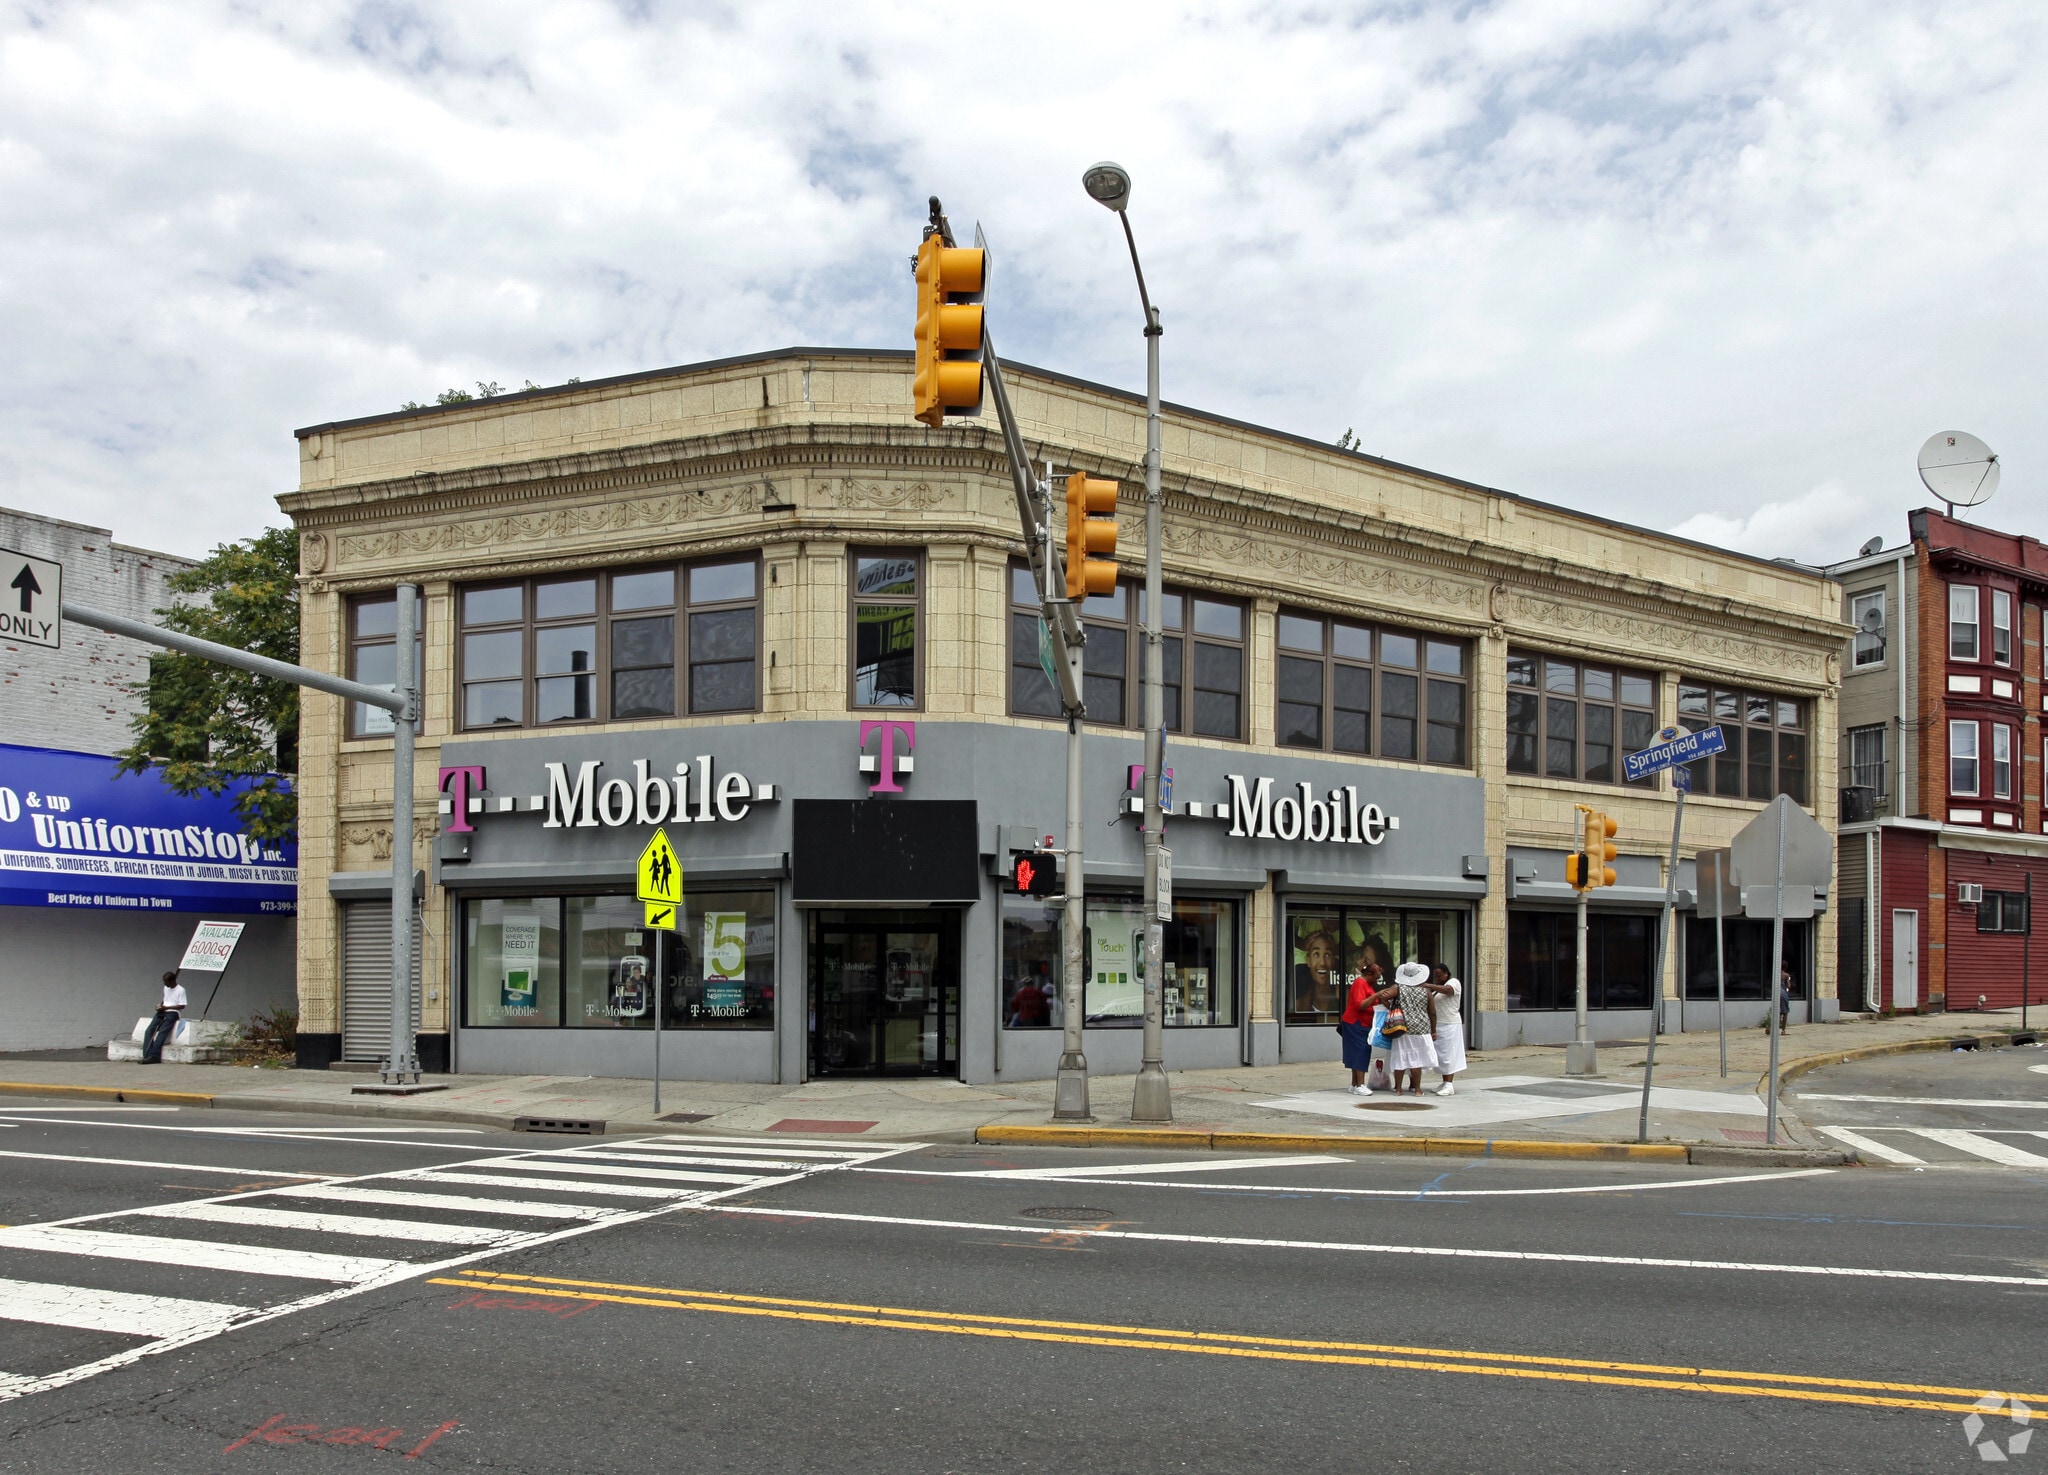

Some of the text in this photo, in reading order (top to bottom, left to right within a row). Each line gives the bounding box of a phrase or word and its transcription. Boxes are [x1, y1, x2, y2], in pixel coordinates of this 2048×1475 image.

[0, 613, 53, 640] ONLY
[1628, 736, 1698, 770] Springfield
[1702, 730, 1717, 741] Ave
[1697, 750, 1706, 758] AND
[26, 791, 42, 808] &
[46, 795, 71, 812] up
[30, 813, 260, 864] UniformStop
[3, 853, 54, 869] UNIFORMS,
[114, 861, 149, 875] AFRICAN
[150, 863, 184, 877] FASHION
[185, 866, 195, 877] IN
[197, 867, 228, 880] JUNIOR,
[229, 868, 252, 880] MISSY
[254, 869, 261, 881] &
[262, 869, 280, 881] PLUS
[1159, 877, 1171, 894] BLOCK
[48, 892, 172, 908] Best Price Of Uniform In Town
[200, 927, 241, 939] AVAILABLE
[505, 926, 536, 934] COVERAGE
[505, 940, 536, 949] NEED IT
